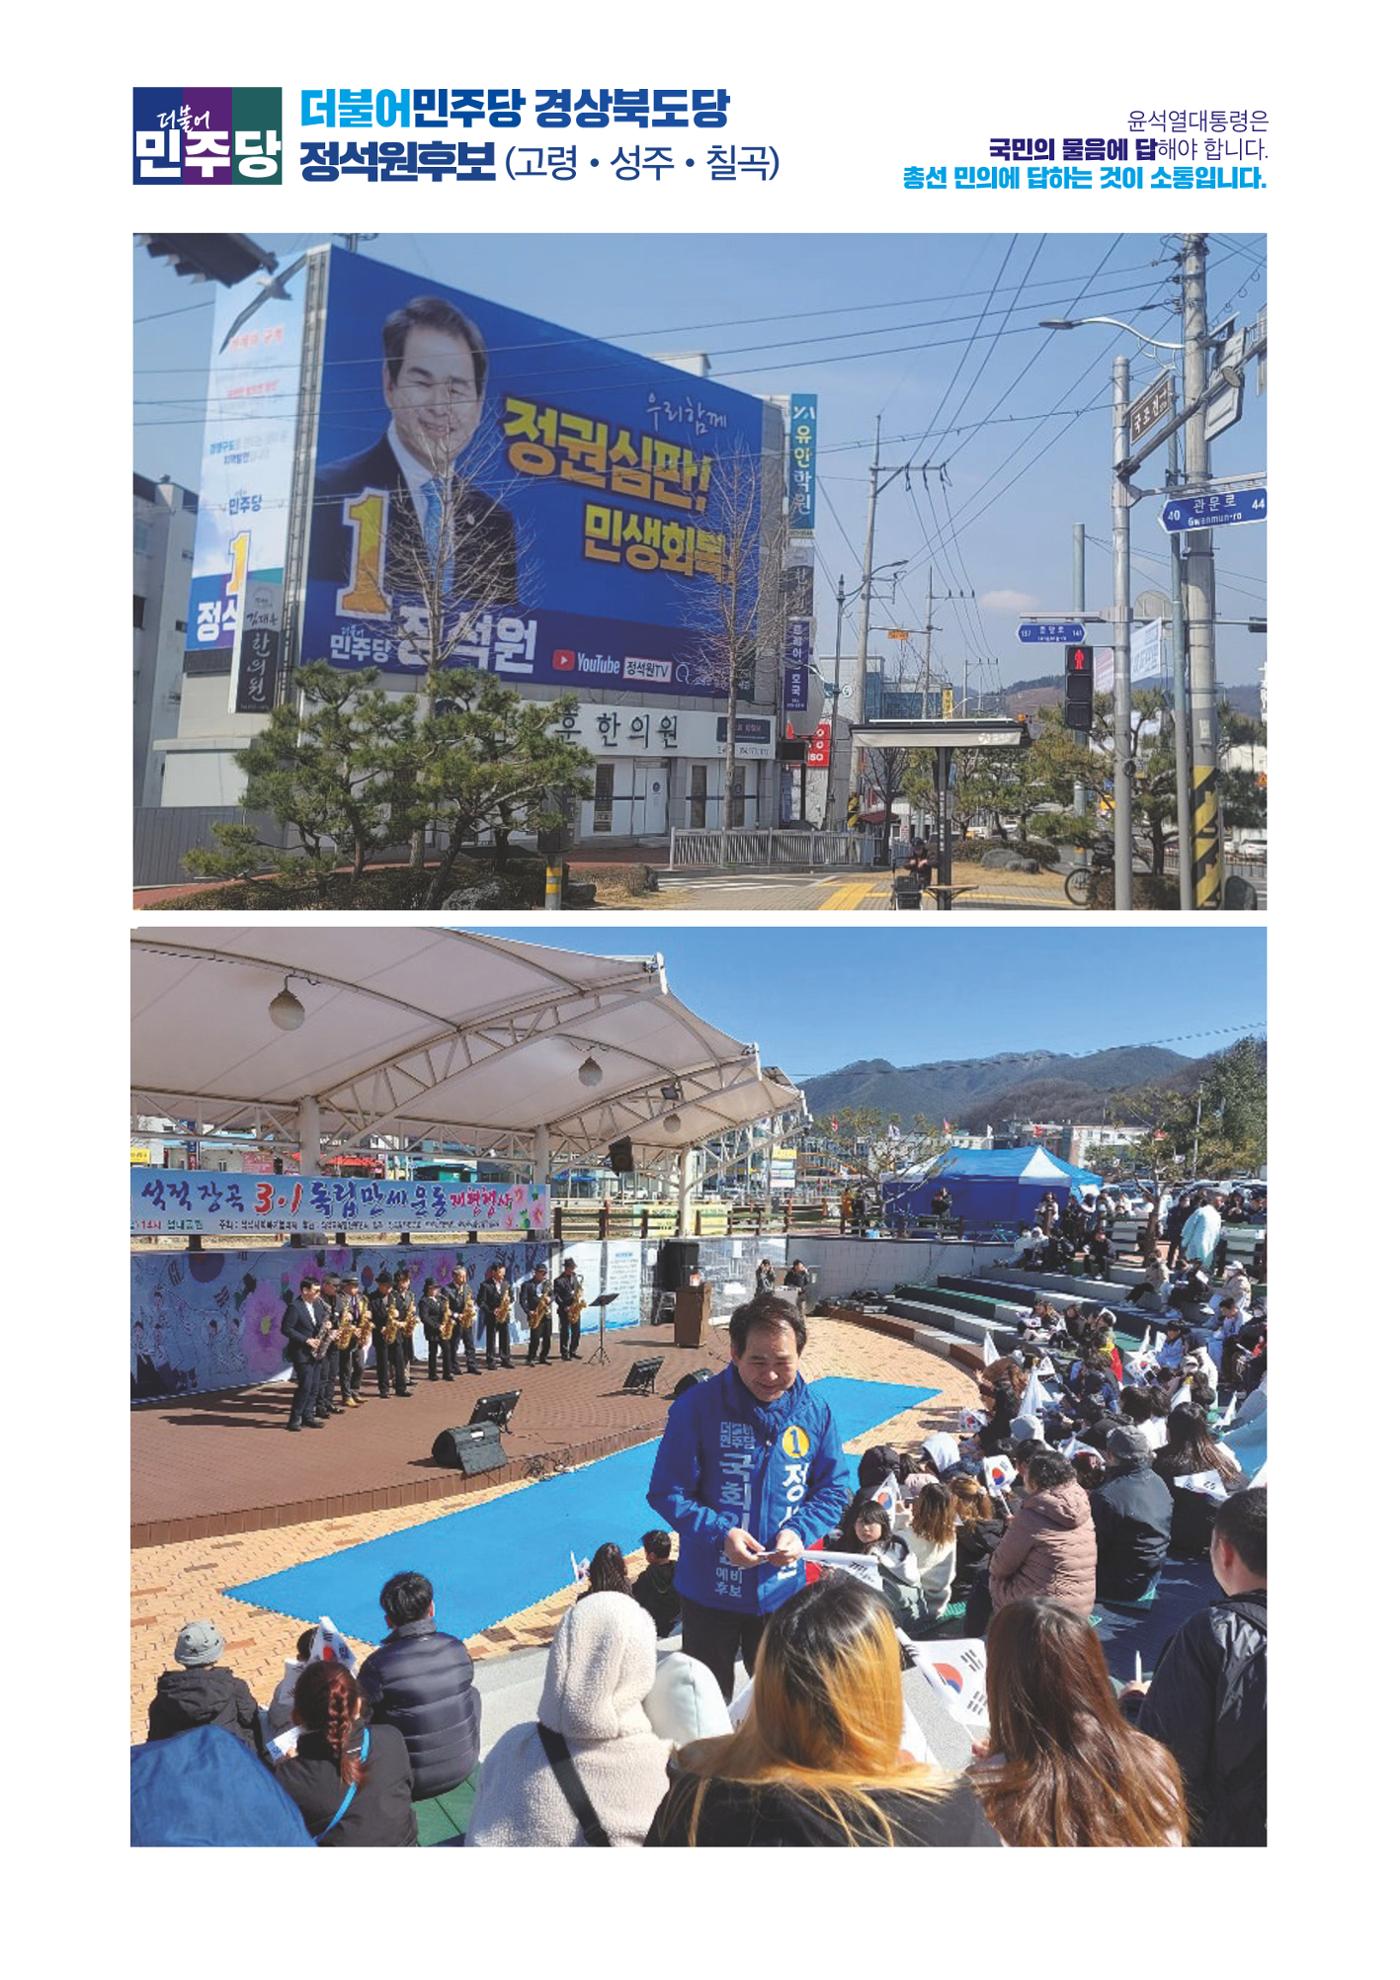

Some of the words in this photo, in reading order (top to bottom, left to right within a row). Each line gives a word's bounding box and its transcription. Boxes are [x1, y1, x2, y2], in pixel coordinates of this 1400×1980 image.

[157, 104, 211, 134] 더불어
[301, 88, 526, 128] 더불어민주당
[535, 89, 730, 128] 경상북도당
[1128, 110, 1269, 133] 윤석열대통령은
[135, 129, 282, 178] 민주당
[300, 141, 496, 182] 정석원후보
[506, 145, 576, 181] (고령
[610, 145, 674, 181] 성주
[706, 145, 779, 181] 칠곡)
[990, 138, 1055, 161] 국민의
[1062, 138, 1128, 161] 물음에
[1136, 138, 1198, 161] 답해야
[1204, 138, 1268, 160] 합니다.
[903, 166, 947, 189] 총선
[954, 166, 1020, 189] 민의에
[1027, 166, 1092, 189] 답하는
[1100, 166, 1143, 189] 것이
[1151, 166, 1267, 189] 소통입니다.
[646, 393, 728, 435] 우리함께
[503, 397, 711, 512] 정권심판!
[229, 494, 262, 515] 민주당
[1168, 510, 1181, 522] 40
[1193, 494, 1237, 514] 관문로
[1252, 497, 1265, 510] 44
[1188, 511, 1242, 527] Gwanmun-ro
[337, 487, 392, 619] 1
[584, 503, 736, 585] 민생회복
[227, 530, 252, 595] 1
[330, 634, 392, 663] 민주당
[398, 606, 538, 674] 정석원
[247, 631, 271, 702] 한의원
[577, 652, 621, 675] YouTube
[626, 659, 670, 679] 정석원TV
[597, 711, 678, 749] 한의원
[141, 1179, 193, 1212] 석적
[198, 1181, 245, 1213] 장곡
[309, 1181, 448, 1219] 독립만세운동
[789, 1429, 801, 1455] 1
[719, 1452, 755, 1565] 국회의
[715, 1567, 743, 1584] 예비
[715, 1582, 743, 1599] 후보
